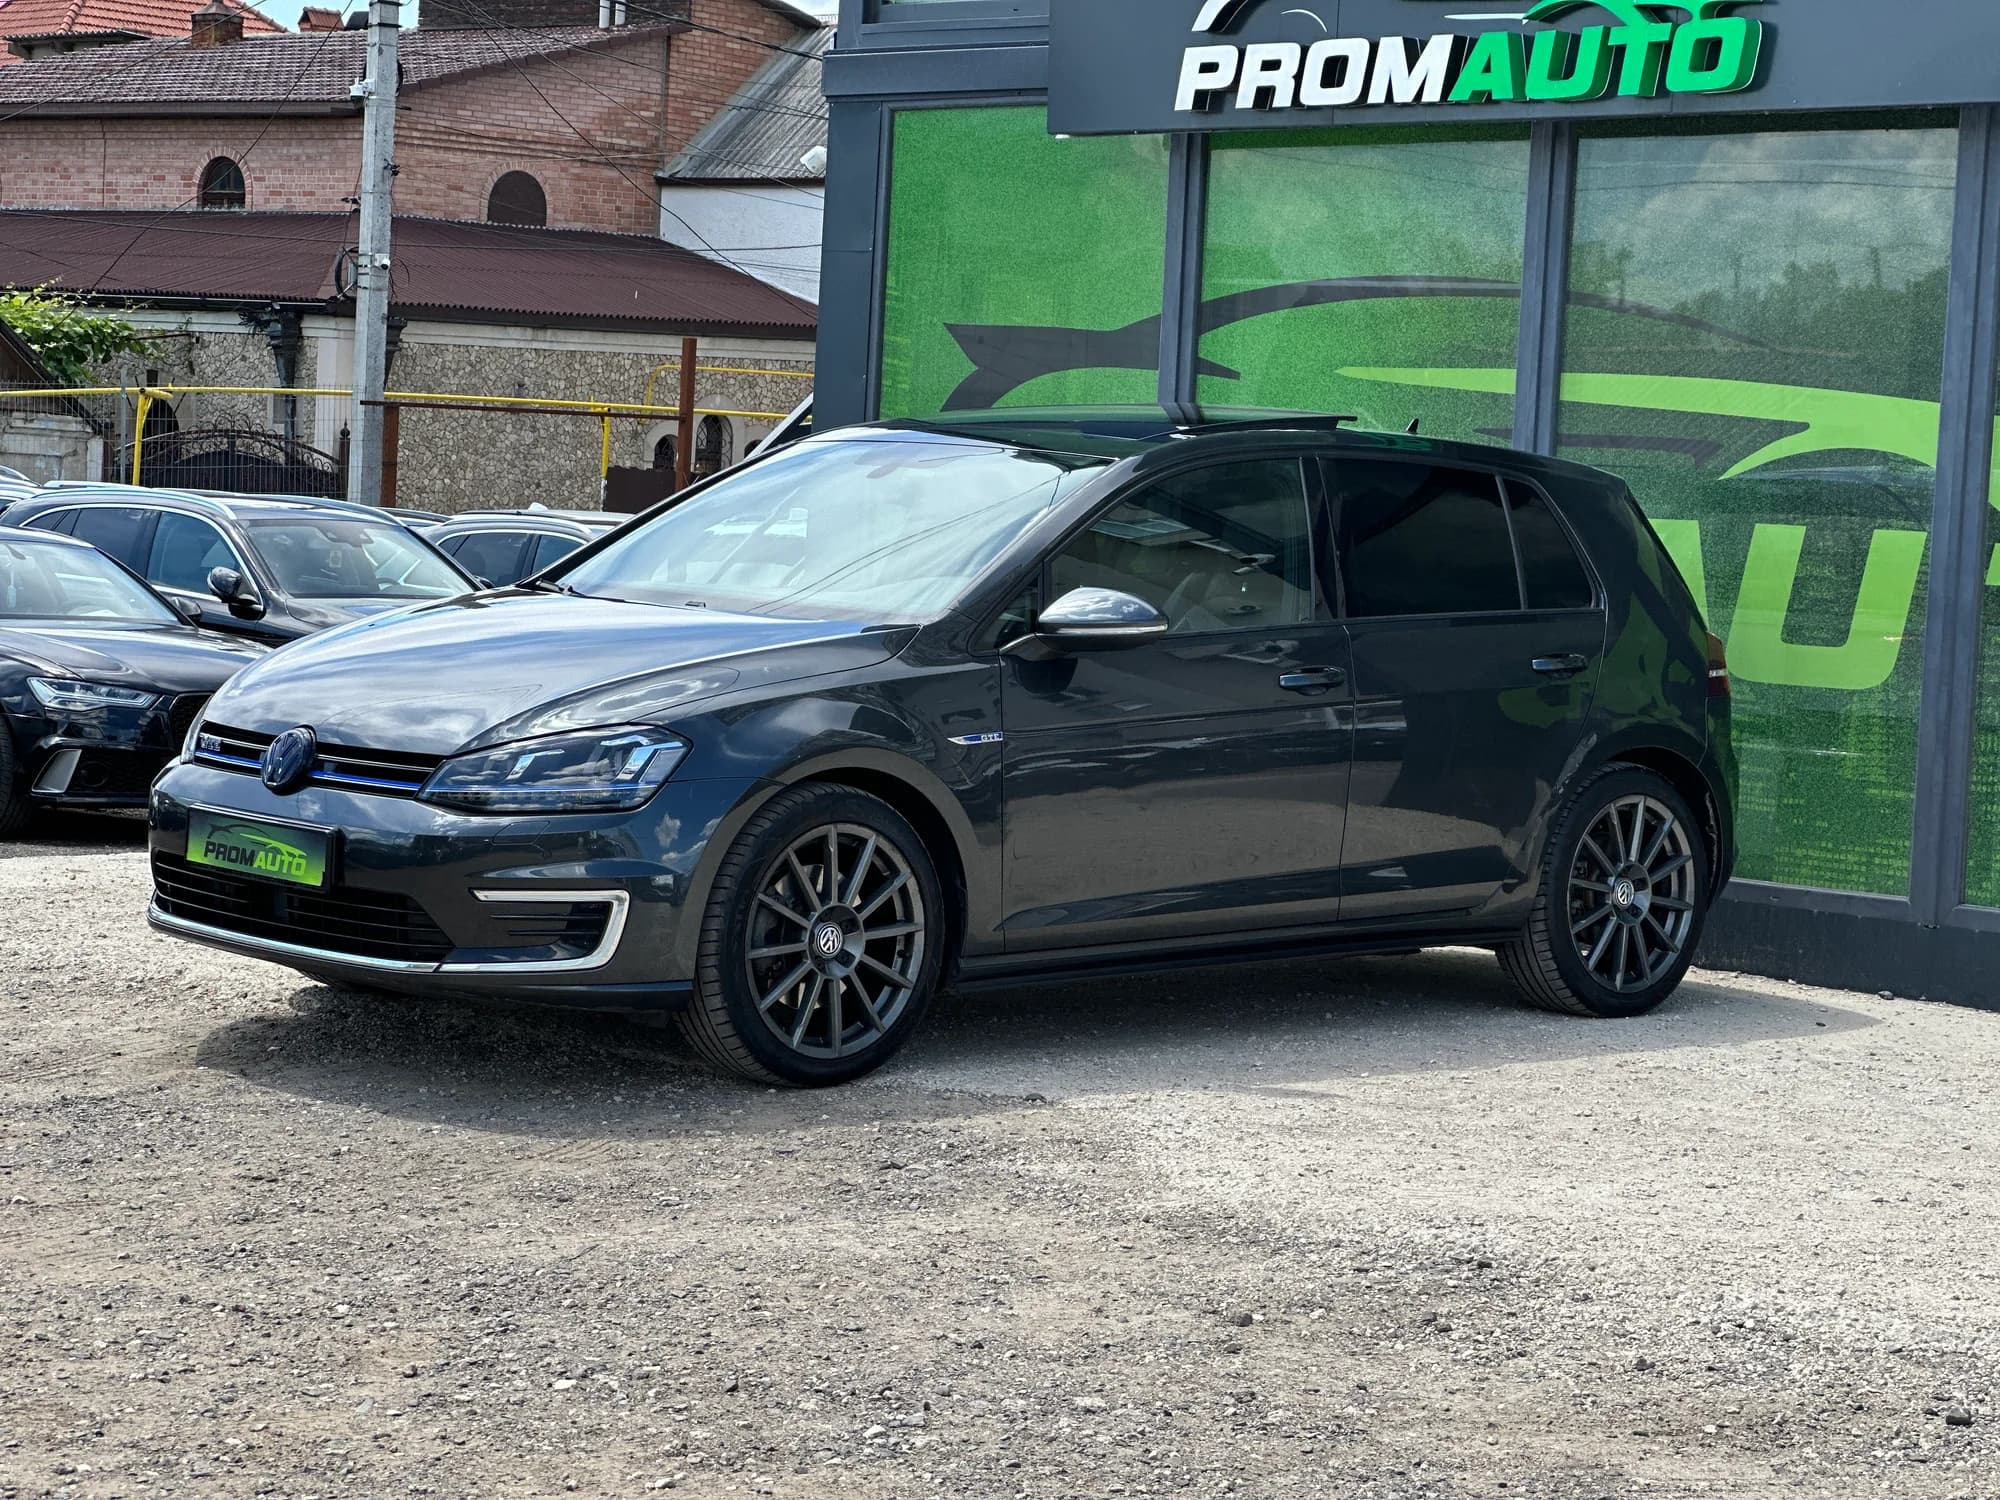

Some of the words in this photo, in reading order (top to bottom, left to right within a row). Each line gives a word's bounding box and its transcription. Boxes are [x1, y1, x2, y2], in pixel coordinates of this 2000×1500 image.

[1174, 17, 1762, 112] PROMAUTO
[981, 732, 1000, 741] GTE
[203, 840, 307, 876] PROMAUTO
